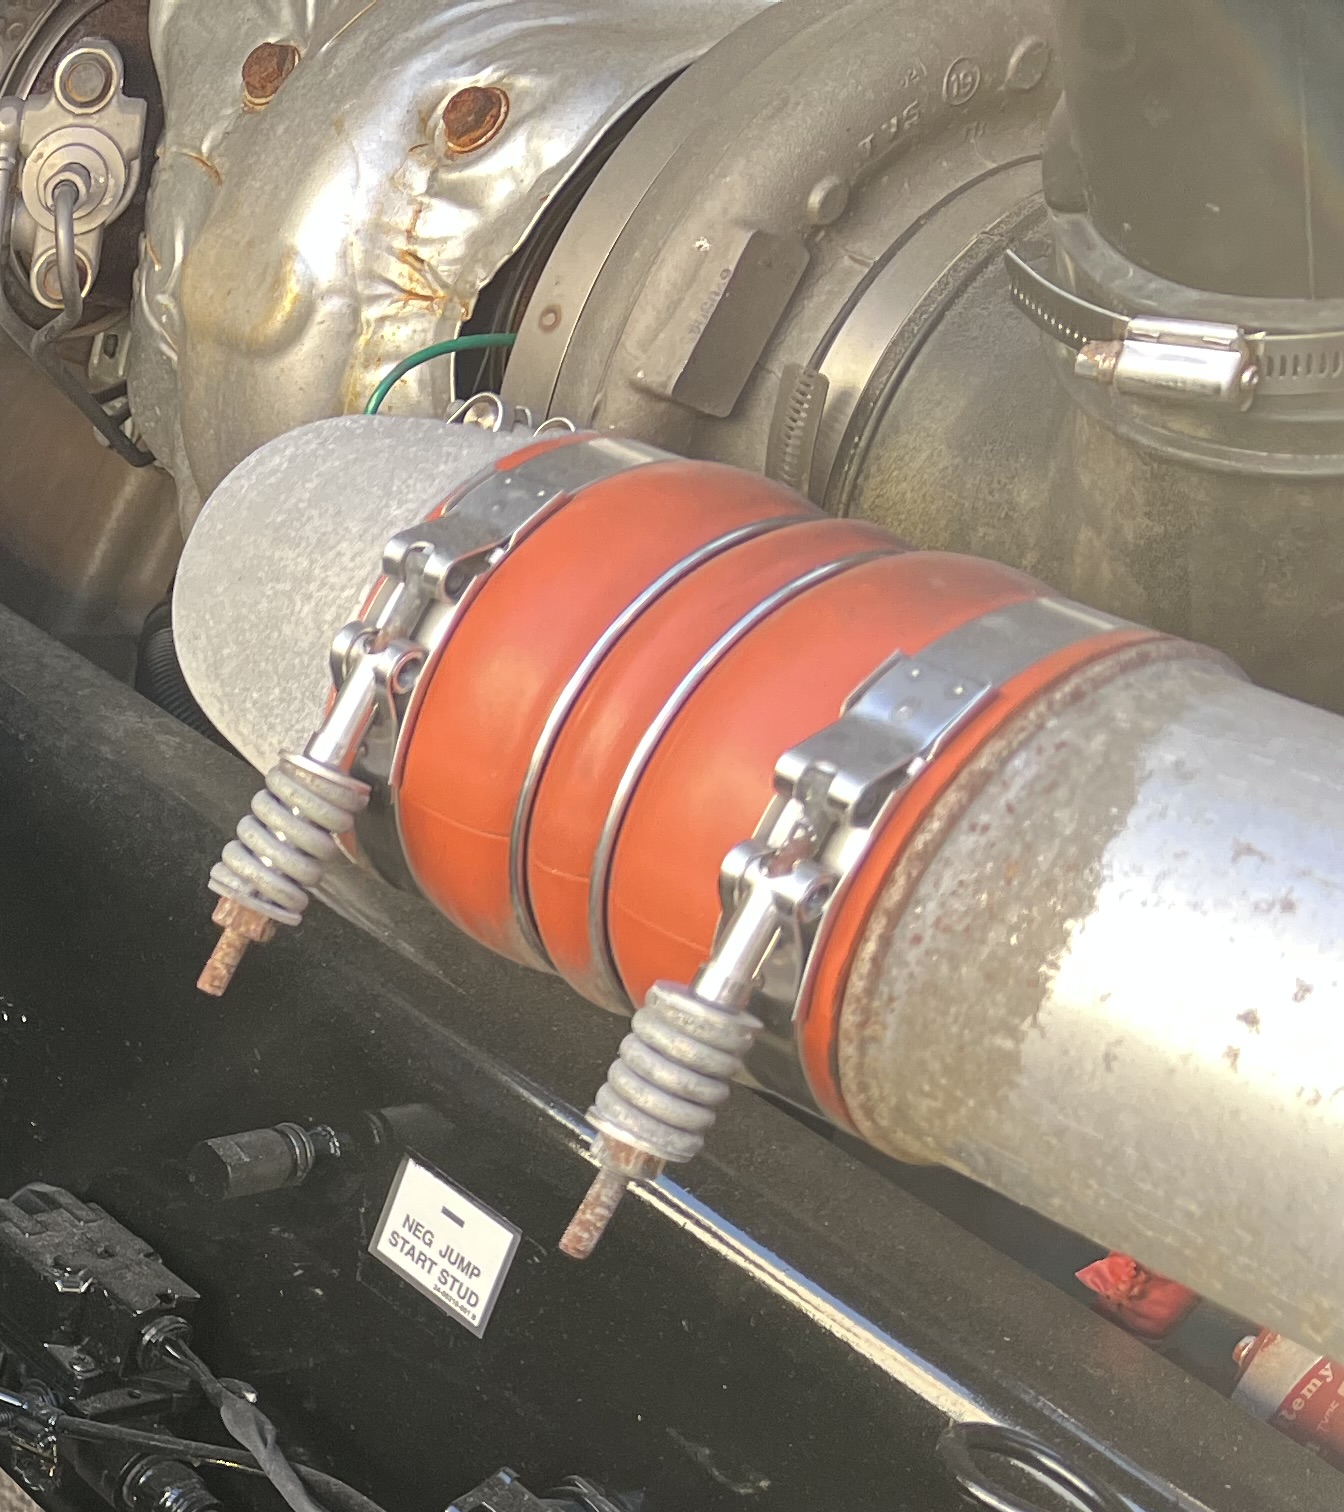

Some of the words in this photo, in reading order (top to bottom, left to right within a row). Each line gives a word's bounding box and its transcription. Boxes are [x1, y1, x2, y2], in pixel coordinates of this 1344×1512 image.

[388, 1230, 438, 1275] START
[437, 1268, 479, 1308] STUD
[402, 1213, 435, 1248] NEG
[438, 1244, 481, 1280] JUMP
